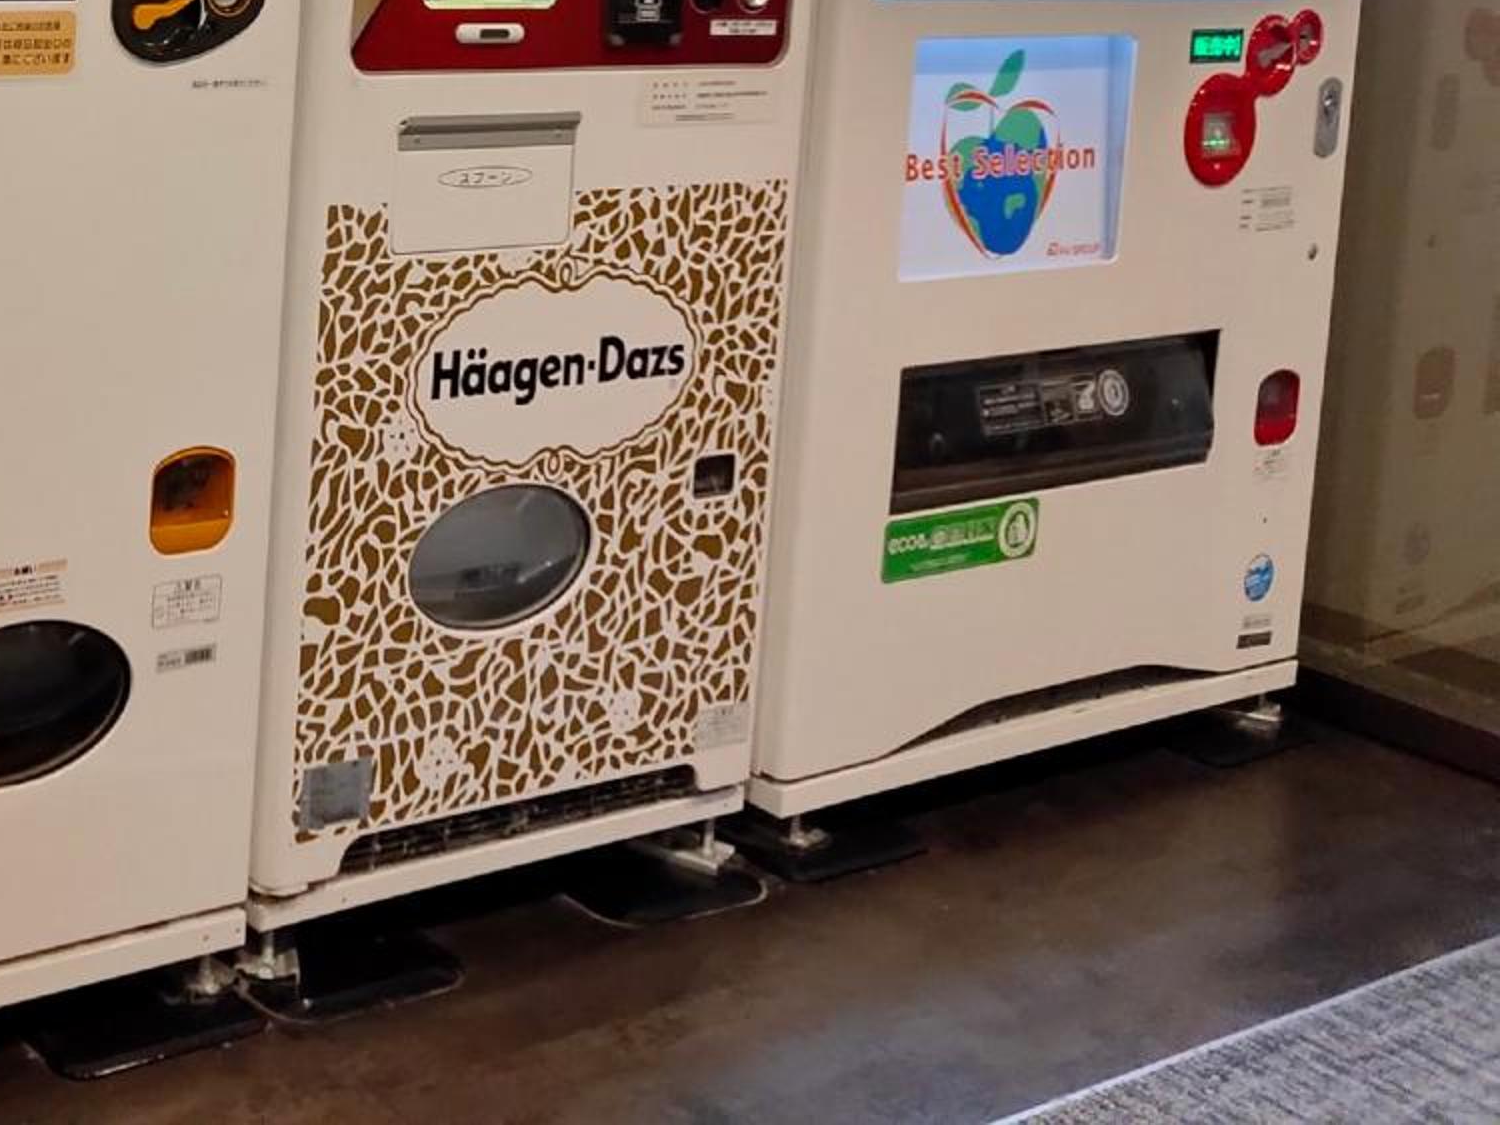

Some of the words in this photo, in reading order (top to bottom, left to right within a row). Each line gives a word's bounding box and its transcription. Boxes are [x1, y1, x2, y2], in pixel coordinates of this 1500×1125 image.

[904, 153, 962, 182] Best
[971, 143, 1096, 180] Selection
[430, 335, 685, 406] Häagen-Dazs
